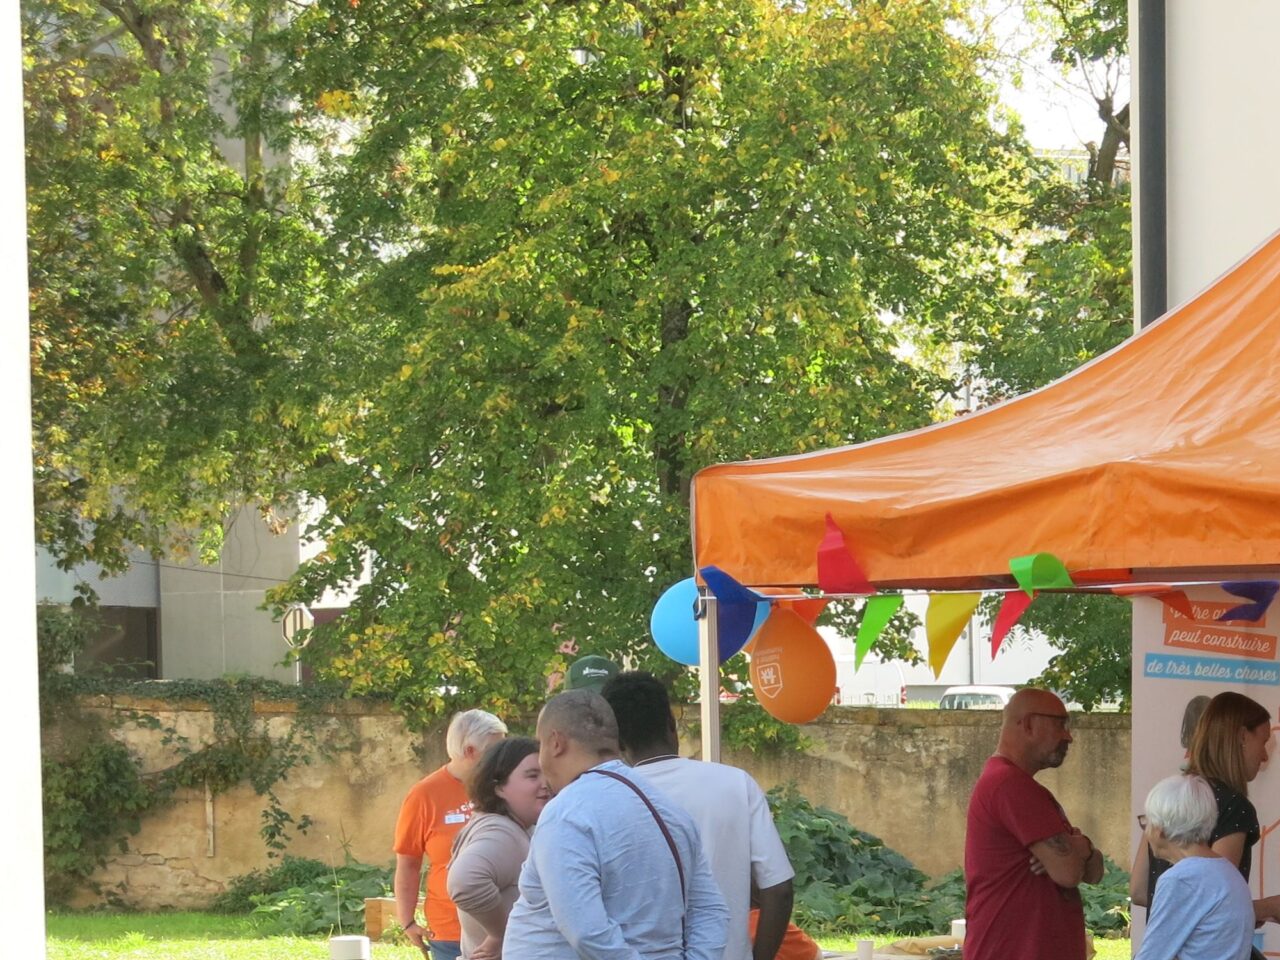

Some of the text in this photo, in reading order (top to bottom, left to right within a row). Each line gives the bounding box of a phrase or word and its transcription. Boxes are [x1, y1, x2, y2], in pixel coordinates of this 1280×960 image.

[1169, 629, 1271, 652] peut construire
[1147, 659, 1279, 681] de très belles choses
